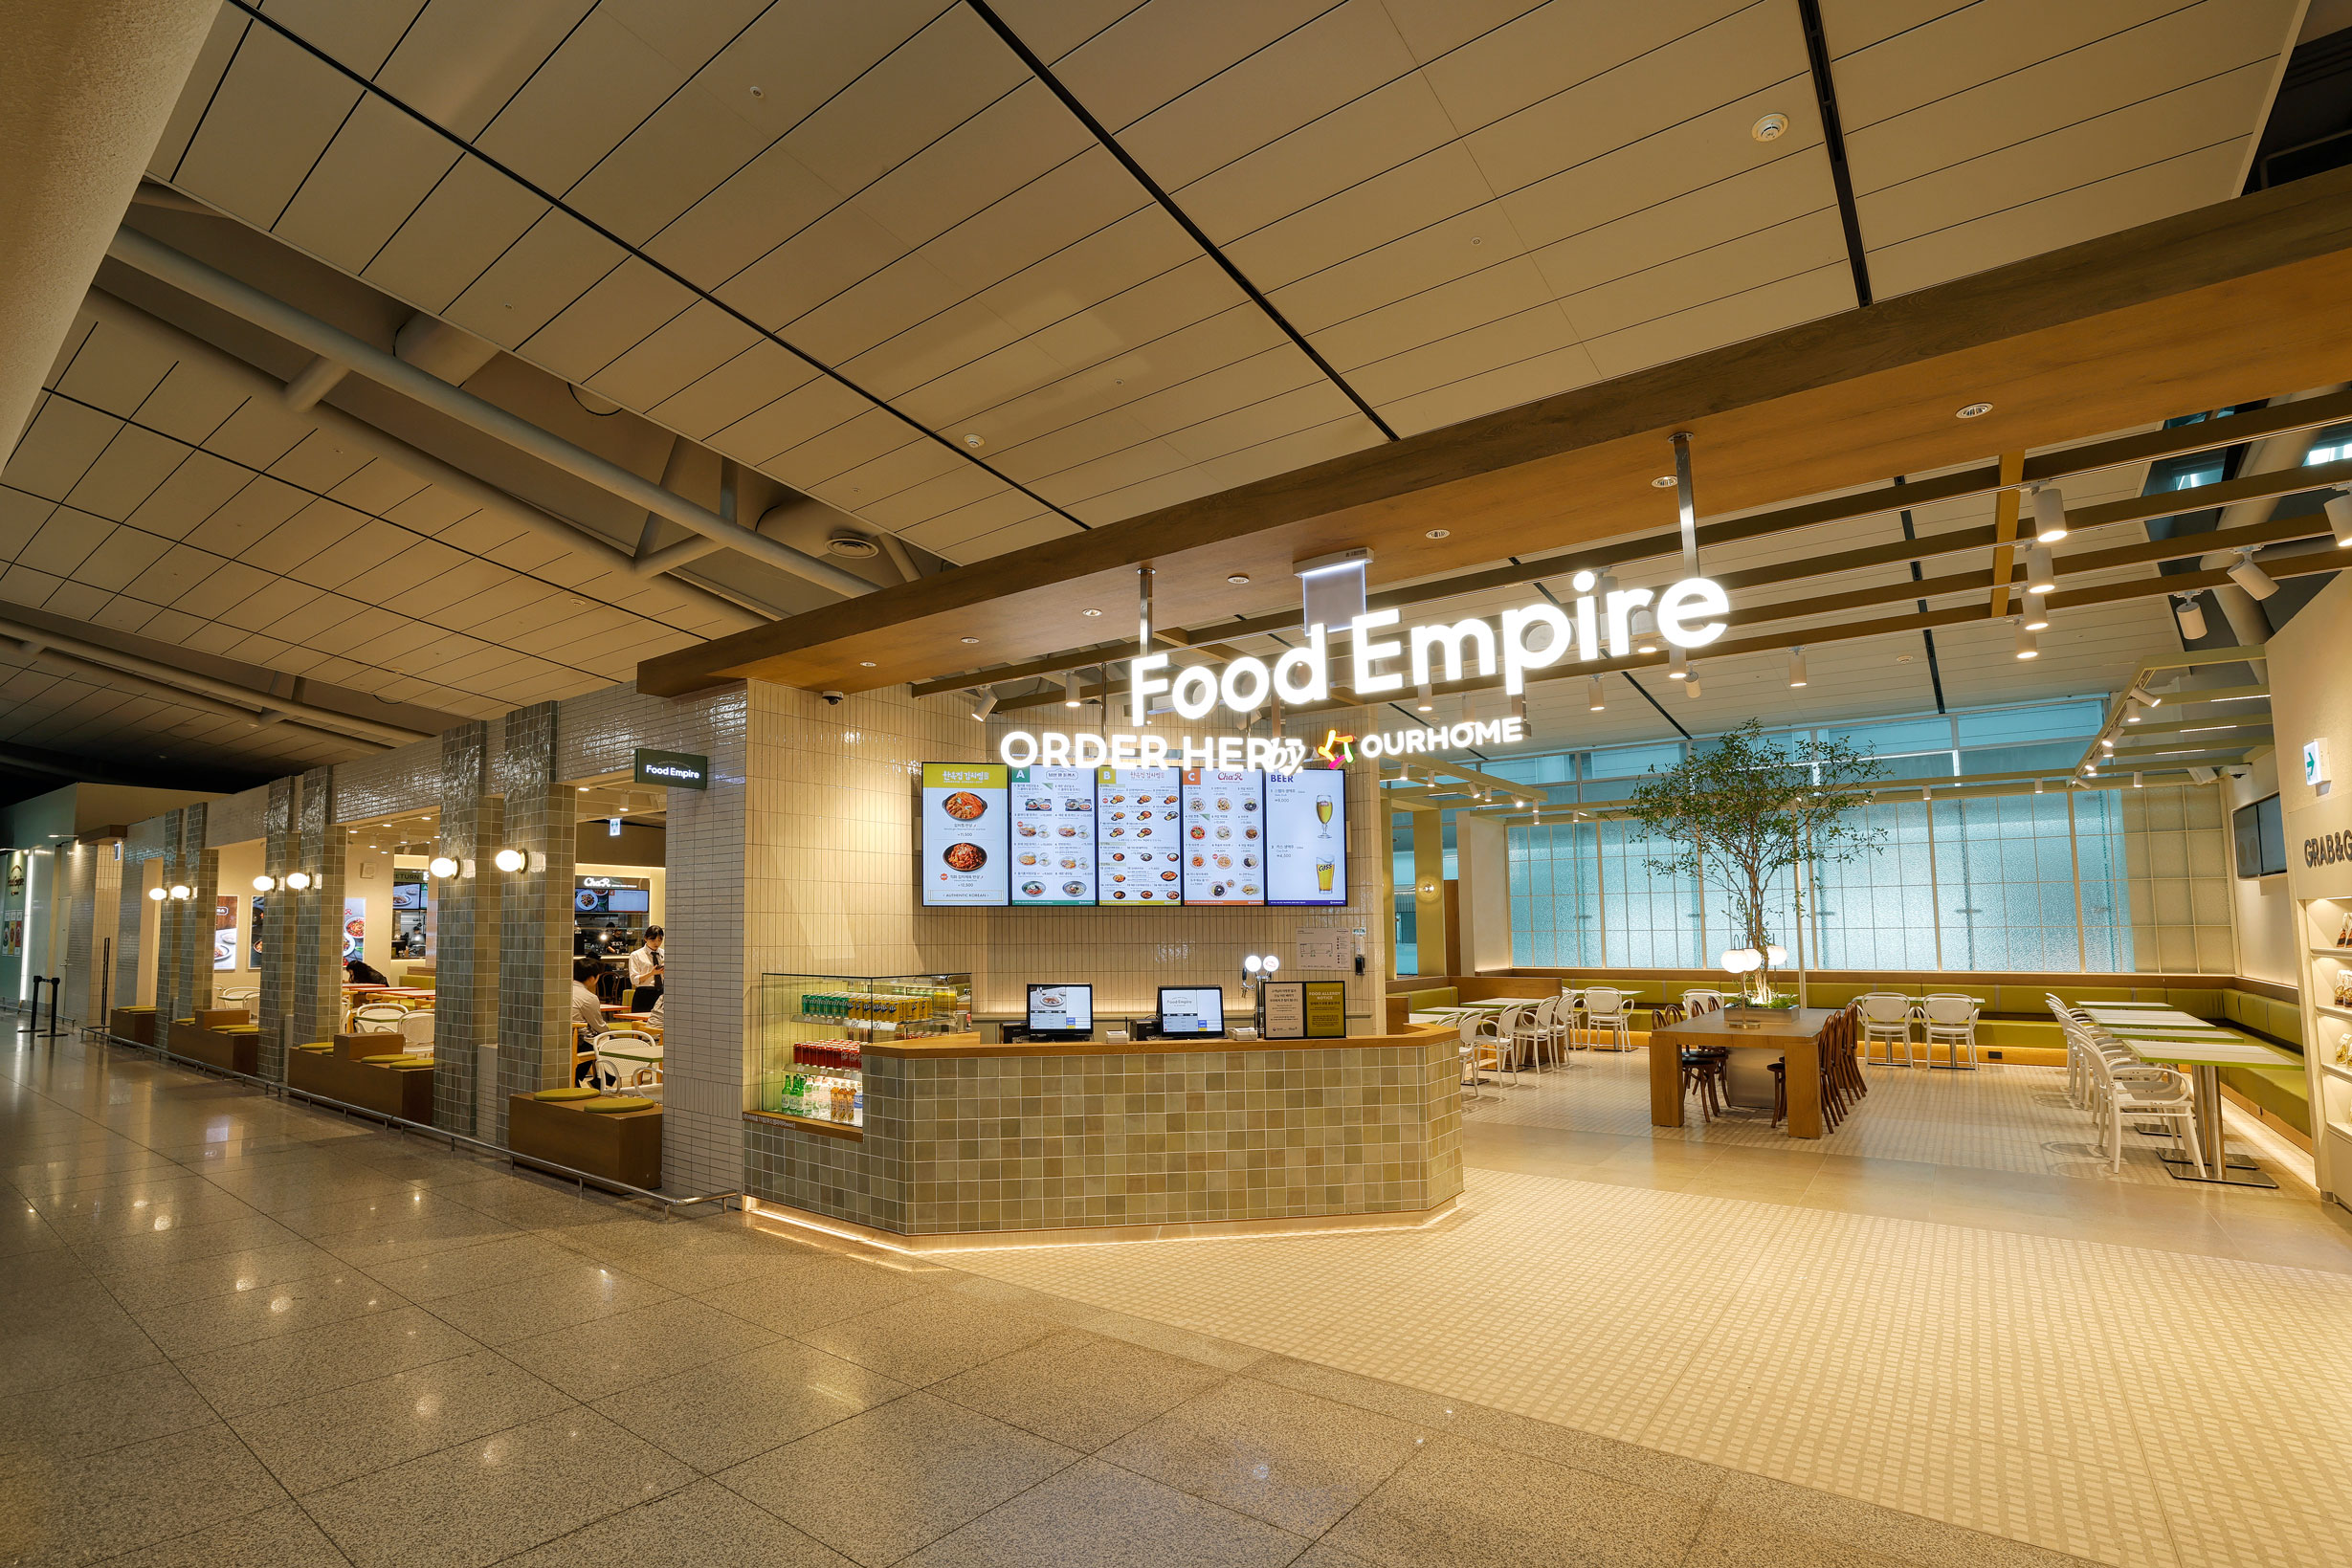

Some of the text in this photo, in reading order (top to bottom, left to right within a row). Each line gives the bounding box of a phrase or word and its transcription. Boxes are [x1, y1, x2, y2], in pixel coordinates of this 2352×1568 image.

[1131, 570, 1730, 727] Food Empire
[1000, 731, 1169, 771] ORDER
[1269, 717, 1523, 777] by OURHOME
[646, 764, 669, 776] Food
[670, 767, 700, 780] Empire
[1015, 769, 1026, 779] A
[1102, 770, 1112, 780] B
[1187, 772, 1196, 782] C
[1270, 774, 1294, 783] BEER
